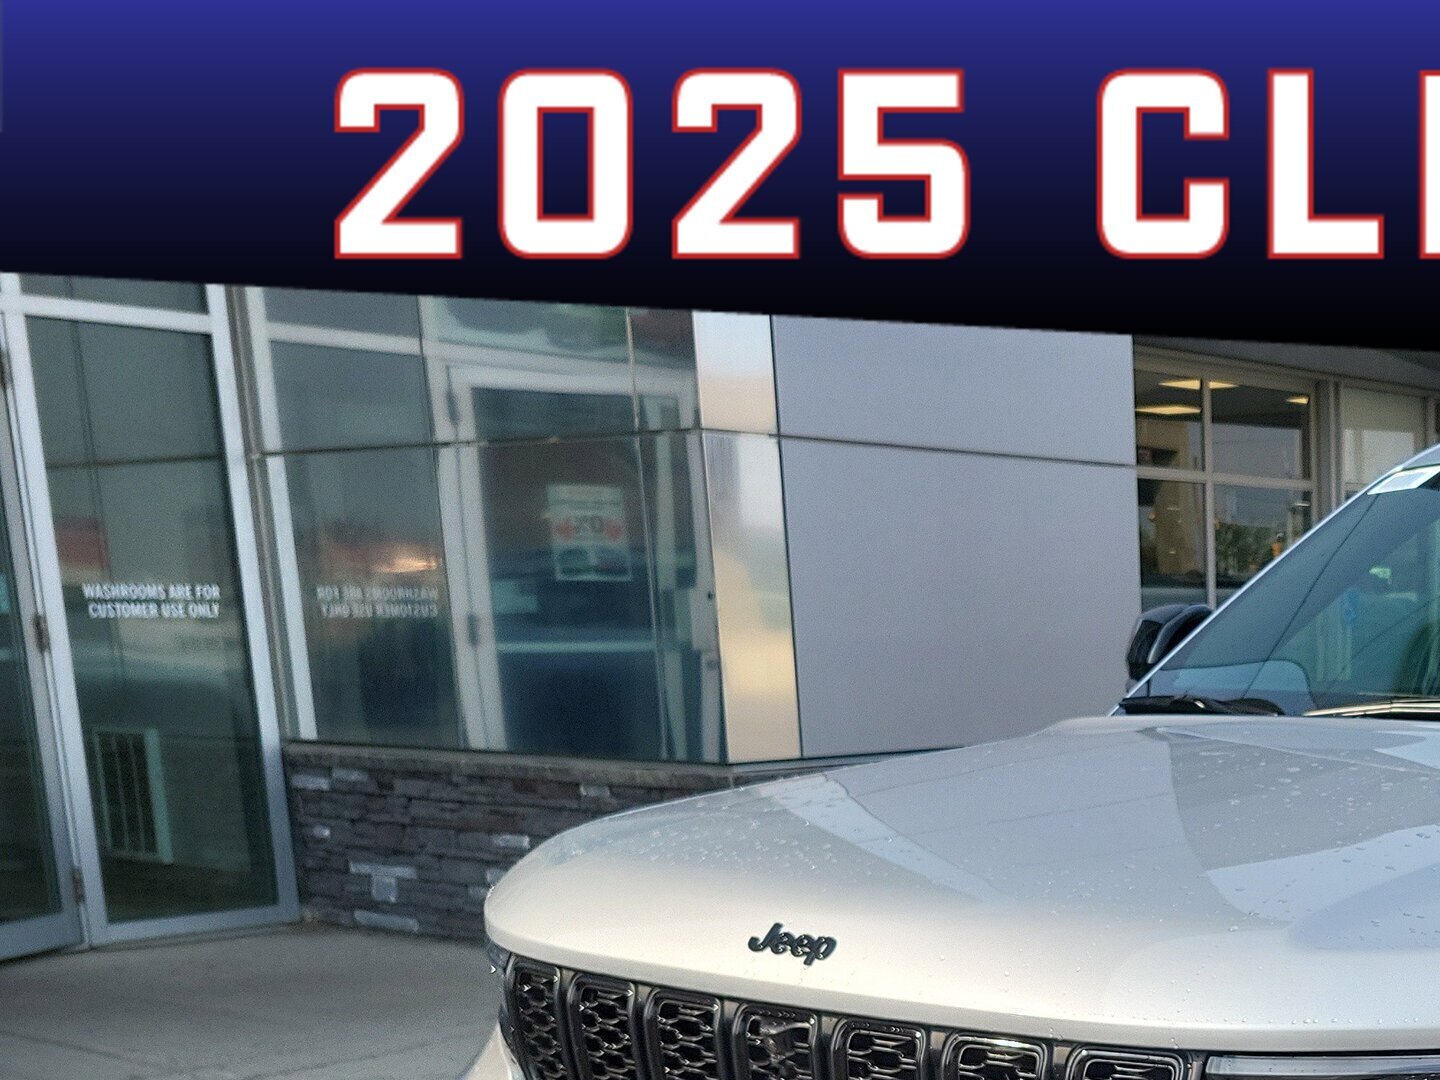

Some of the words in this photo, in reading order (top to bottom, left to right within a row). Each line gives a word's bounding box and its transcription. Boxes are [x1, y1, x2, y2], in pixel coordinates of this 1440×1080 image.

[82, 583, 166, 600] WASHROOMS
[168, 583, 194, 600] ARE
[195, 583, 221, 600] FOR
[88, 601, 159, 618] CUSTOMER
[161, 601, 187, 618] USE
[188, 601, 220, 618] ONLY
[748, 922, 837, 966] Jeep
